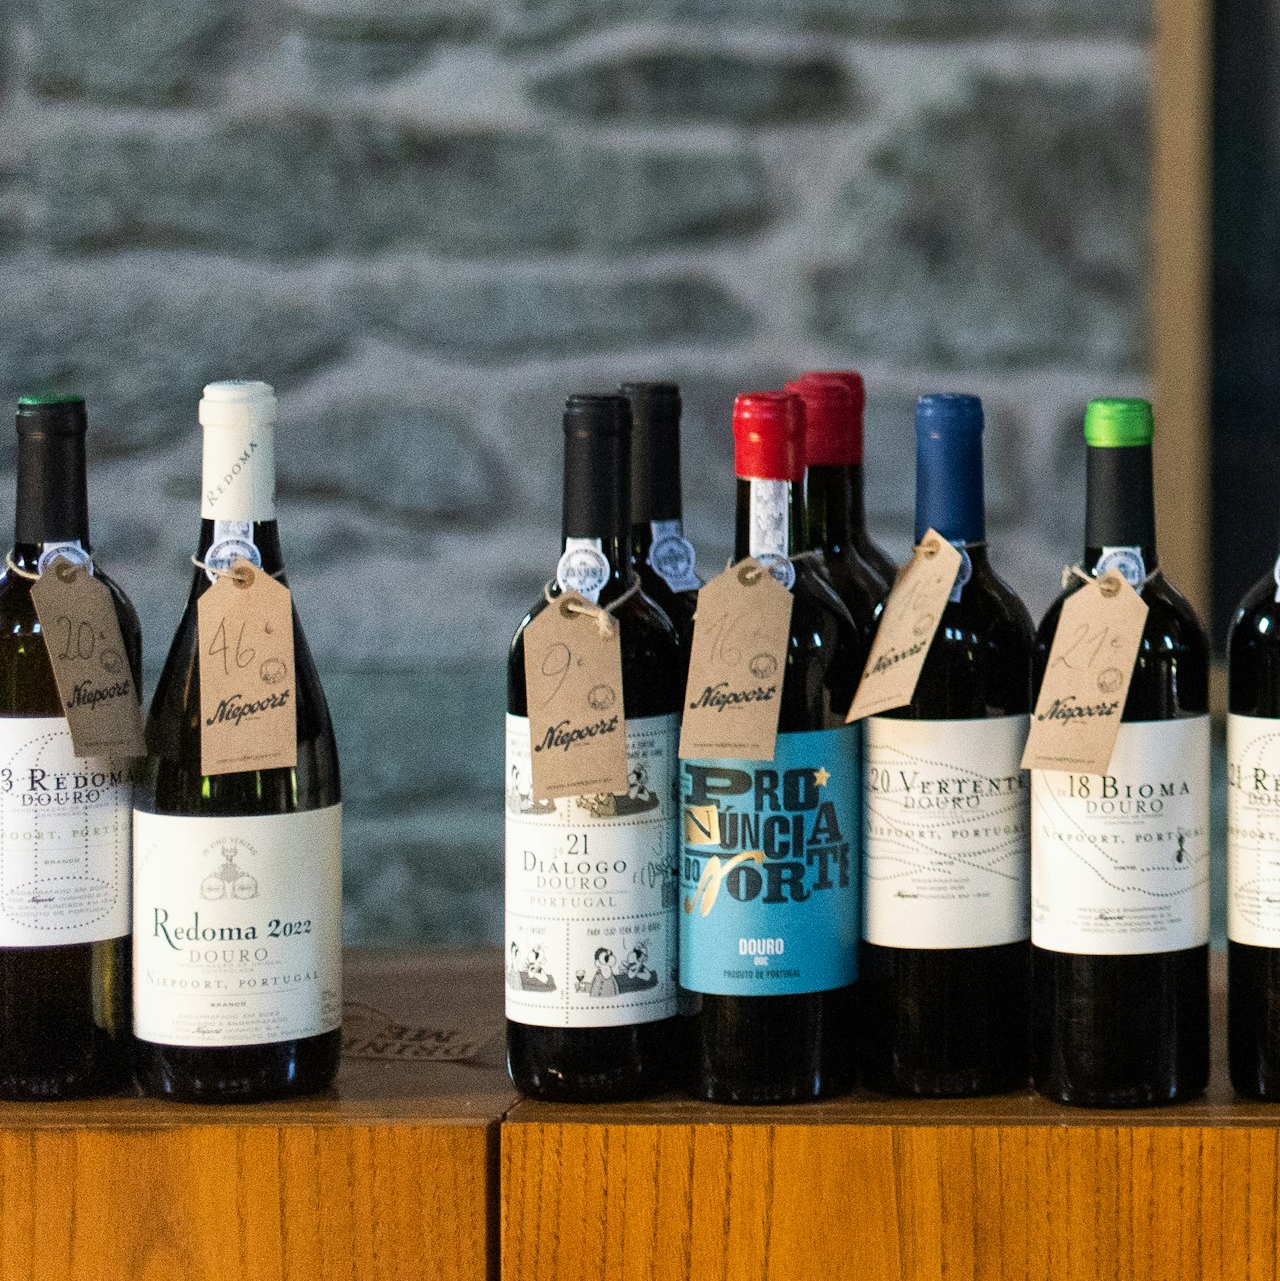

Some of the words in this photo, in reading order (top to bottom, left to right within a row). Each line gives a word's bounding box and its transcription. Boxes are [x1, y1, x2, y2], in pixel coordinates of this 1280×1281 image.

[206, 441, 257, 506] REDOMA
[66, 679, 132, 710] Niepoort
[689, 681, 778, 713] Niepoort
[207, 688, 291, 727] Niepoort
[1038, 695, 1120, 727] Niepoort
[534, 715, 620, 752] Niepoort
[28, 767, 136, 792] REDOMA
[684, 764, 821, 813] PRO
[1069, 775, 1091, 799] 18
[1101, 775, 1190, 799] BIOMA
[21, 789, 103, 807] DOURO
[903, 795, 981, 810] DOURO
[1086, 799, 1164, 815] DOURO
[523, 850, 628, 874] DIALOGO
[537, 875, 608, 891] DOURO
[529, 895, 618, 909] PORTUGAL
[152, 907, 258, 951] Redoma
[266, 918, 312, 938] 2022
[188, 947, 270, 964] DOURO
[738, 937, 785, 956] DOURO
[238, 970, 319, 989] PORTUGAL
